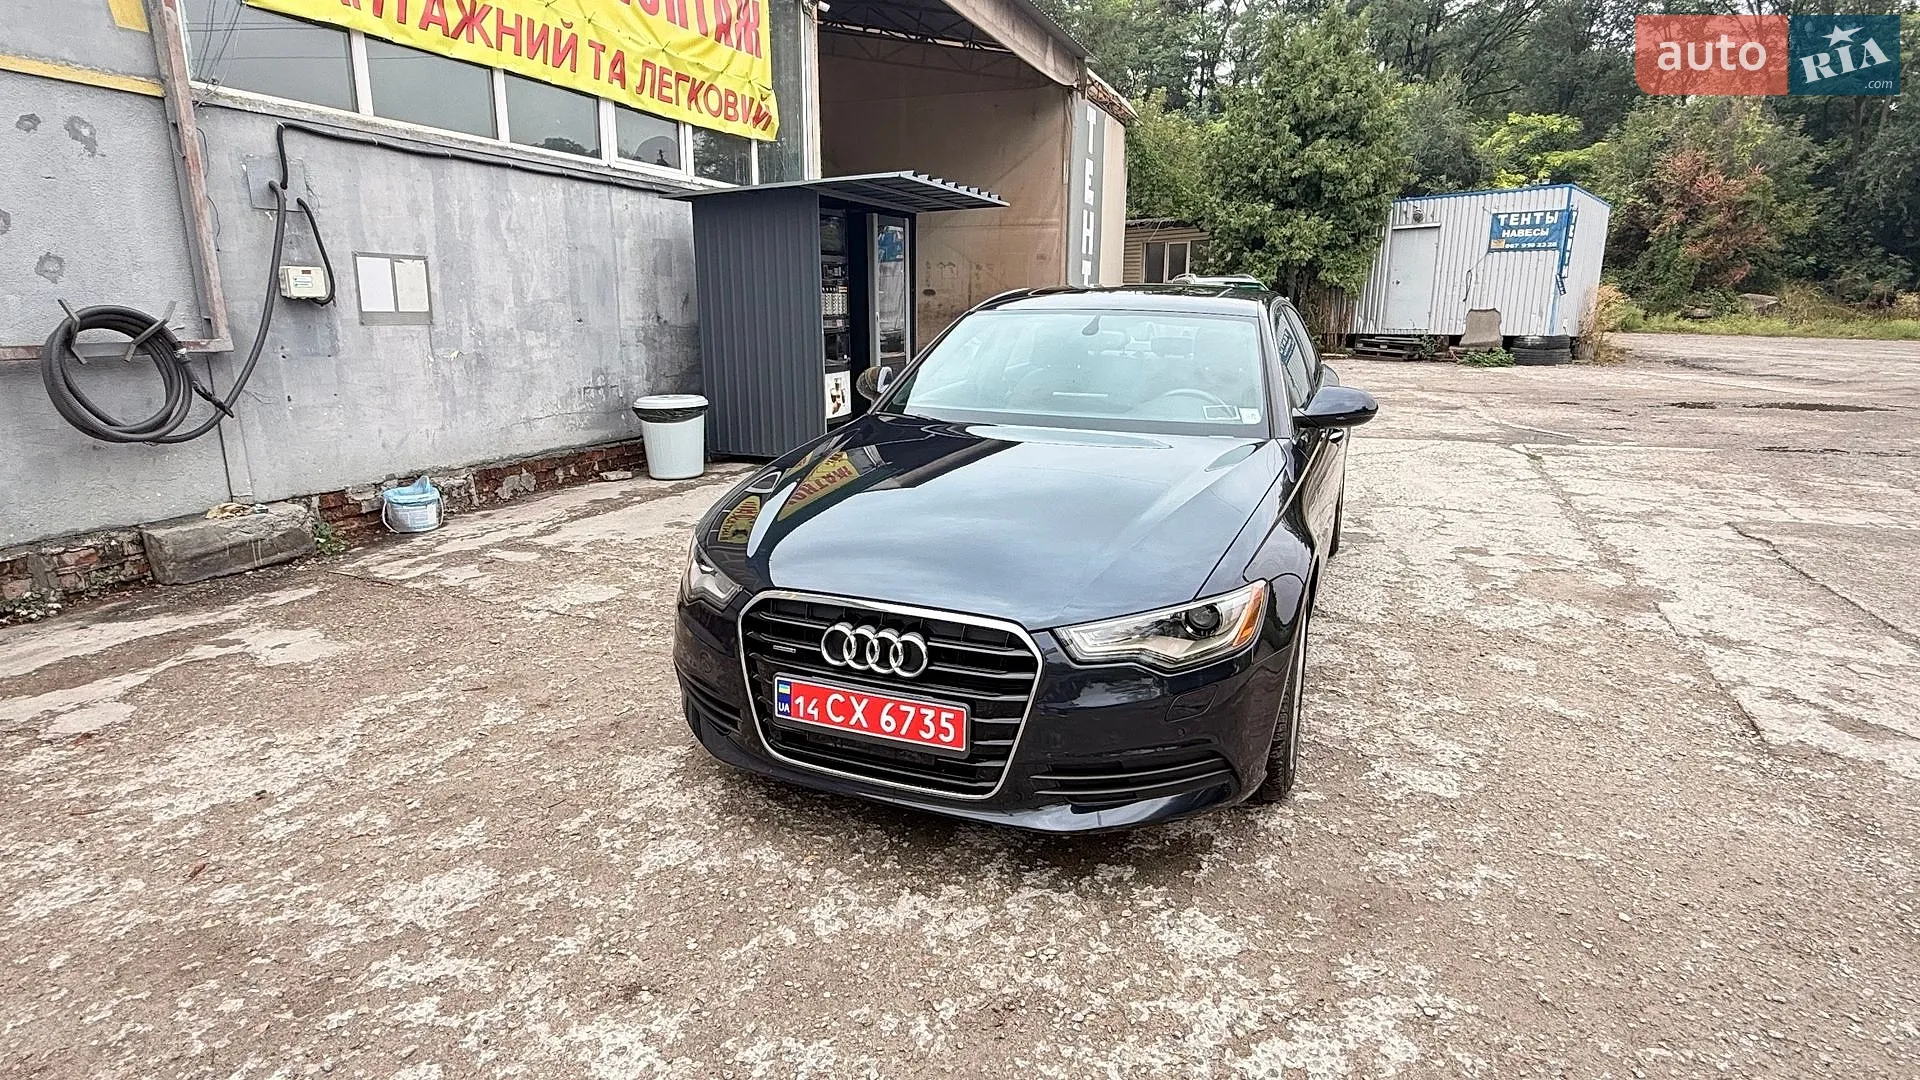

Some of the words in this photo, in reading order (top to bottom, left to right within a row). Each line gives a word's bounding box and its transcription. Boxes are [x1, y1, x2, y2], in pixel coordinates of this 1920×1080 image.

[587, 39, 626, 90] ТА
[635, 58, 772, 131] ЛЕГКОВИЙ
[1498, 211, 1559, 227] ТЕНТЫ
[1501, 228, 1550, 238] НАВЕСЫ
[778, 702, 791, 713] UA
[794, 696, 819, 721] 14
[879, 702, 956, 743] 6735
